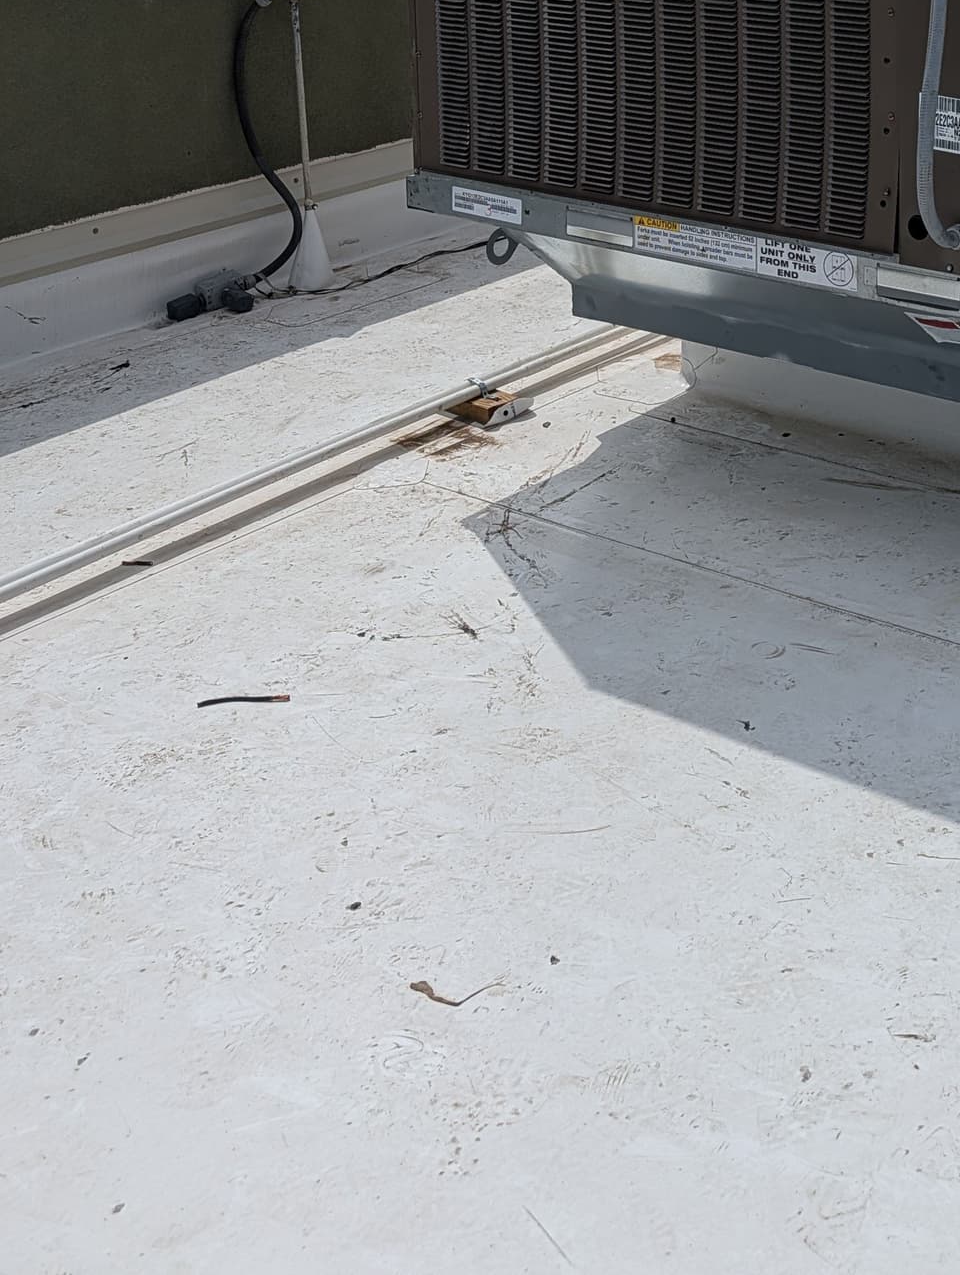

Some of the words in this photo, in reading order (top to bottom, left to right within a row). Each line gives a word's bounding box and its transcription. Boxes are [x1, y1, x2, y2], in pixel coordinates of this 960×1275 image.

[647, 218, 678, 230] CAUTION
[680, 224, 710, 235] HANDLING
[711, 230, 754, 243] INSTRUCTIONS
[765, 238, 785, 249] LIFT
[789, 243, 812, 254] ONE
[759, 255, 789, 268] FROM
[791, 262, 817, 274] THIS
[760, 247, 785, 258] UNIT
[787, 251, 817, 265] ONLY
[776, 268, 799, 279] END
